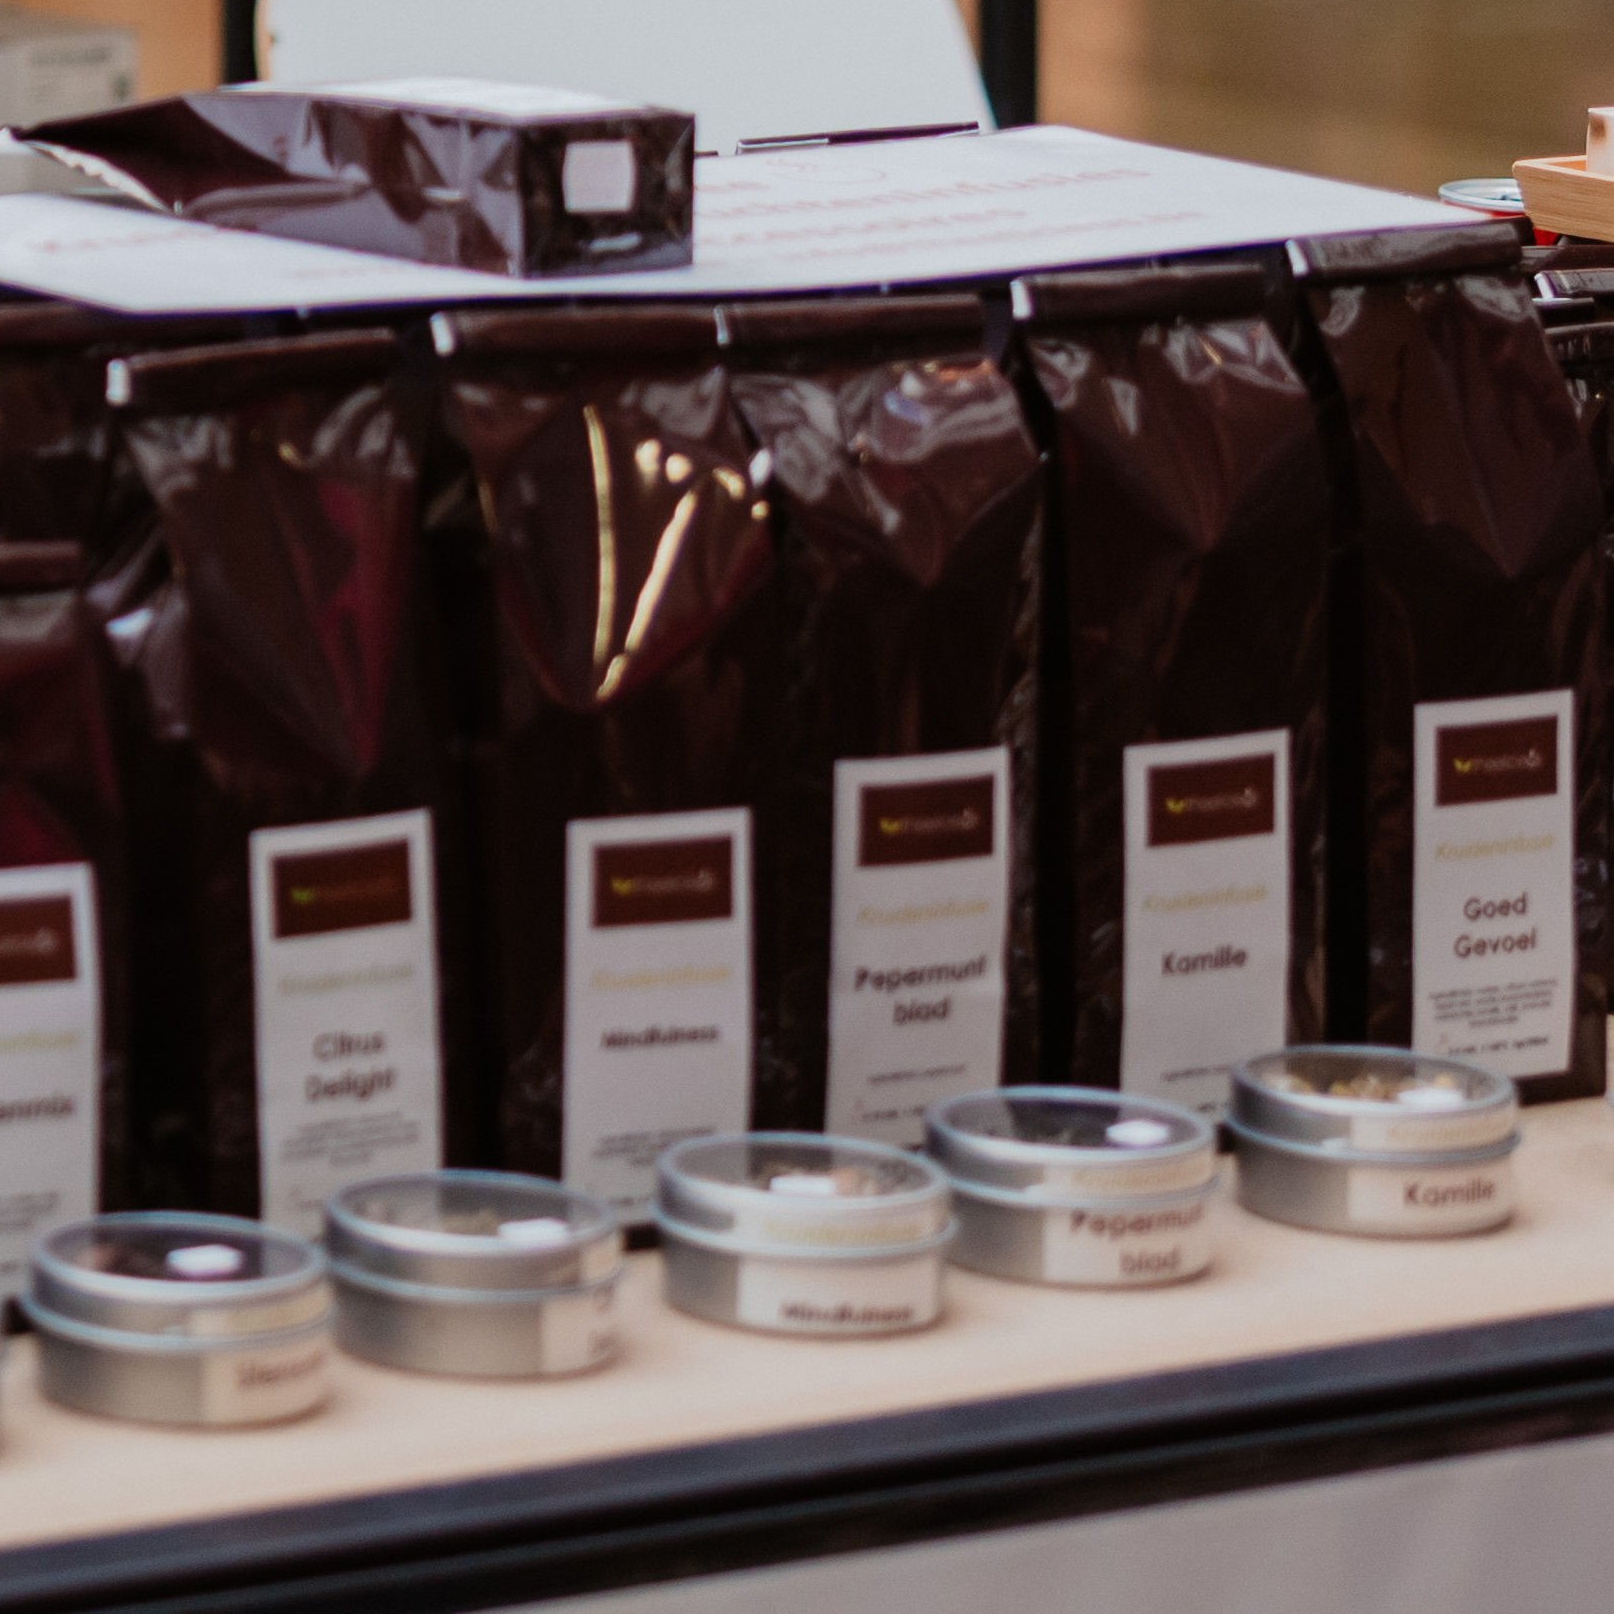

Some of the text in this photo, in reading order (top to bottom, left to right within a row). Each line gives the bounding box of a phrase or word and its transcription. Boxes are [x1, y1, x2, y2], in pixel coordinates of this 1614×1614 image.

[1463, 891, 1529, 921] Goed
[1453, 925, 1538, 959] Gevoel
[854, 952, 987, 994] Pepermunt
[1161, 944, 1248, 976] Kamille
[1403, 1176, 1496, 1208] Kamille
